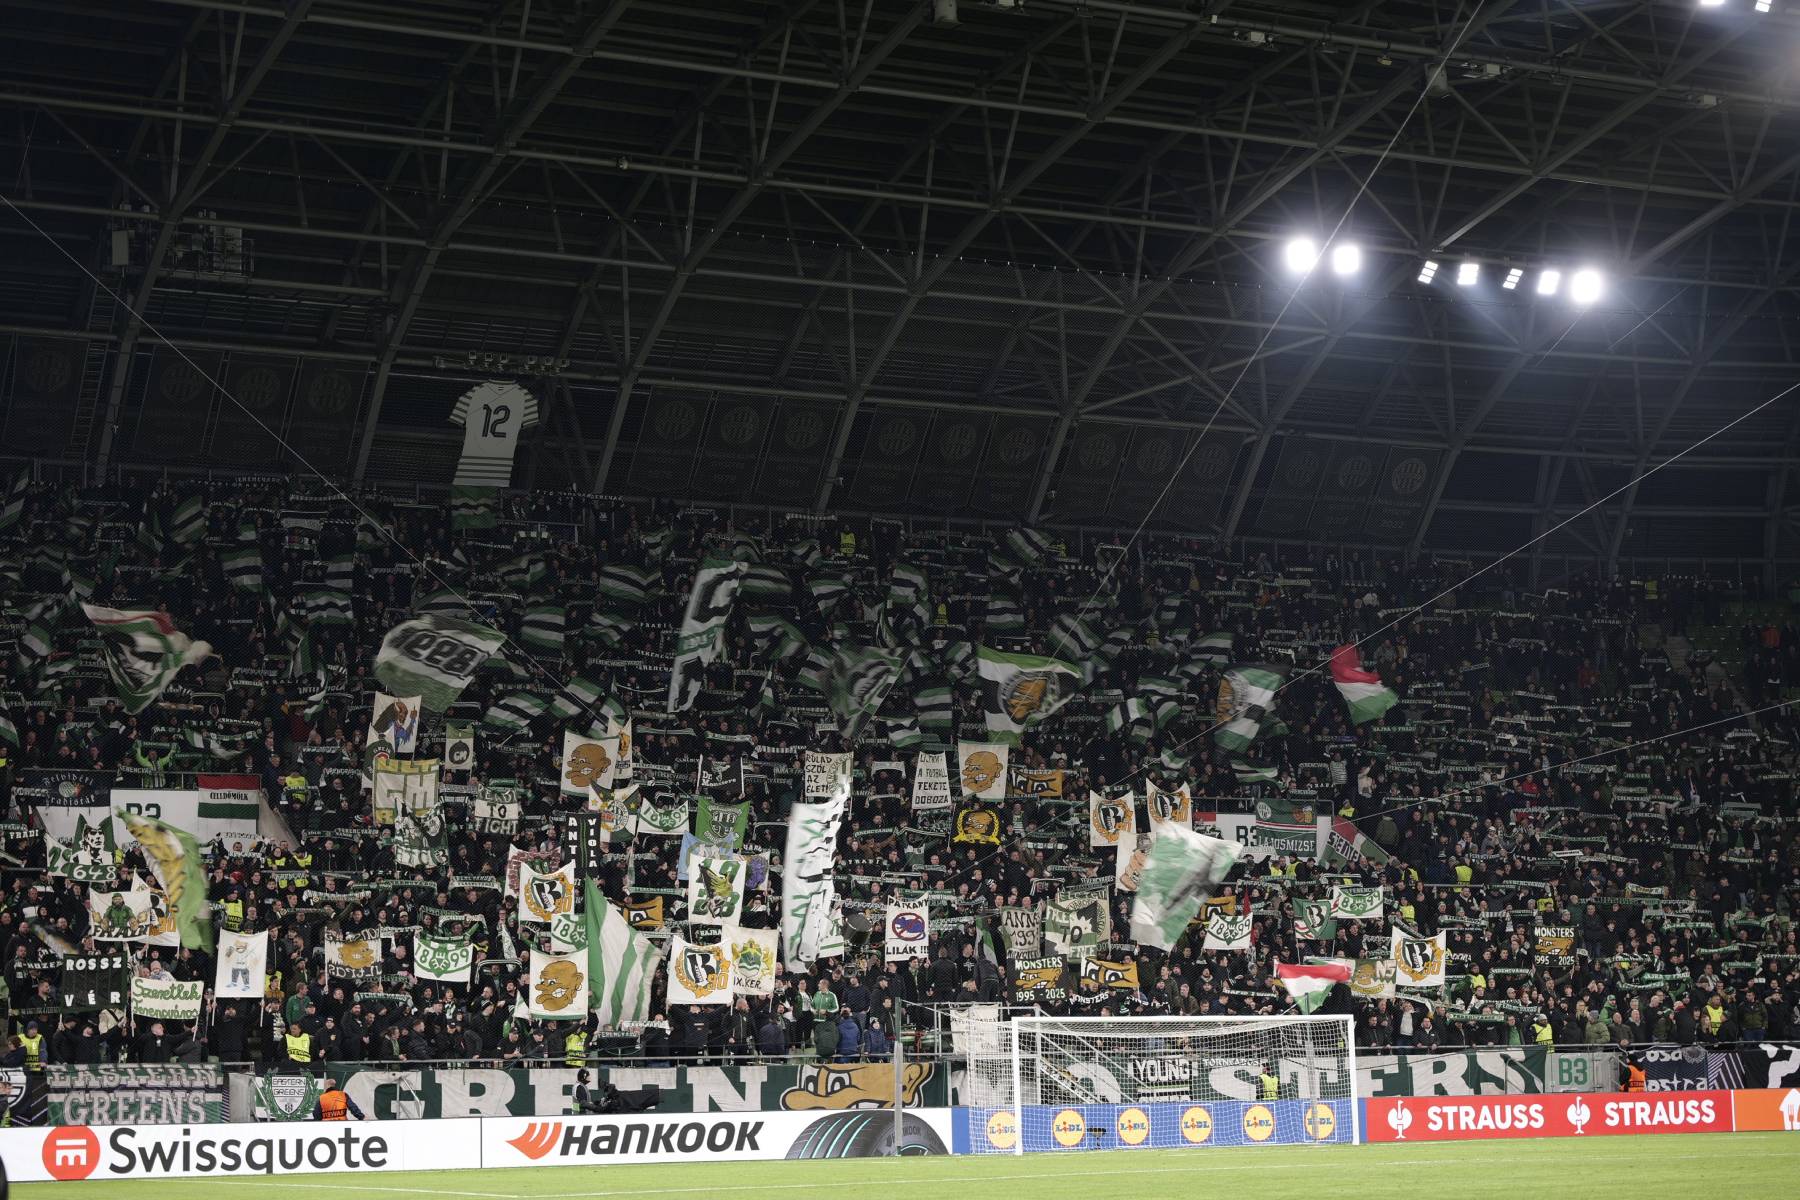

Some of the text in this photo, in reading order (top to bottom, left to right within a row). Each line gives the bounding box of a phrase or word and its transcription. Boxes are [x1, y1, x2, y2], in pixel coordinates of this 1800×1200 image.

[482, 403, 511, 438] 12
[487, 803, 507, 818] TO
[475, 819, 518, 835] FIGHT
[587, 818, 598, 868] VIOLA
[1258, 835, 1315, 852] LAJOSMIZSE
[73, 865, 117, 880] 648
[1059, 925, 1083, 943] TO
[1534, 927, 1574, 938] MONSTERS
[886, 943, 917, 955] LILÁK
[66, 957, 122, 971] ROSSZ
[1015, 956, 1063, 970] MONSTERS
[1558, 956, 1575, 965] 2025
[132, 979, 201, 1000] Szeretlek
[1016, 990, 1035, 1001] 1995
[1045, 988, 1066, 1000] 2025
[46, 1063, 221, 1089] EASTERN
[1134, 1058, 1190, 1082] YOUNG
[1558, 1058, 1588, 1085] B3
[272, 1077, 306, 1086] EASTERN
[272, 1088, 305, 1097] GREENS
[64, 1089, 206, 1125] GREENS
[1605, 1099, 1716, 1127] STRAUSS
[1427, 1103, 1545, 1131] STRAUSS
[109, 1127, 388, 1174] Swissquote
